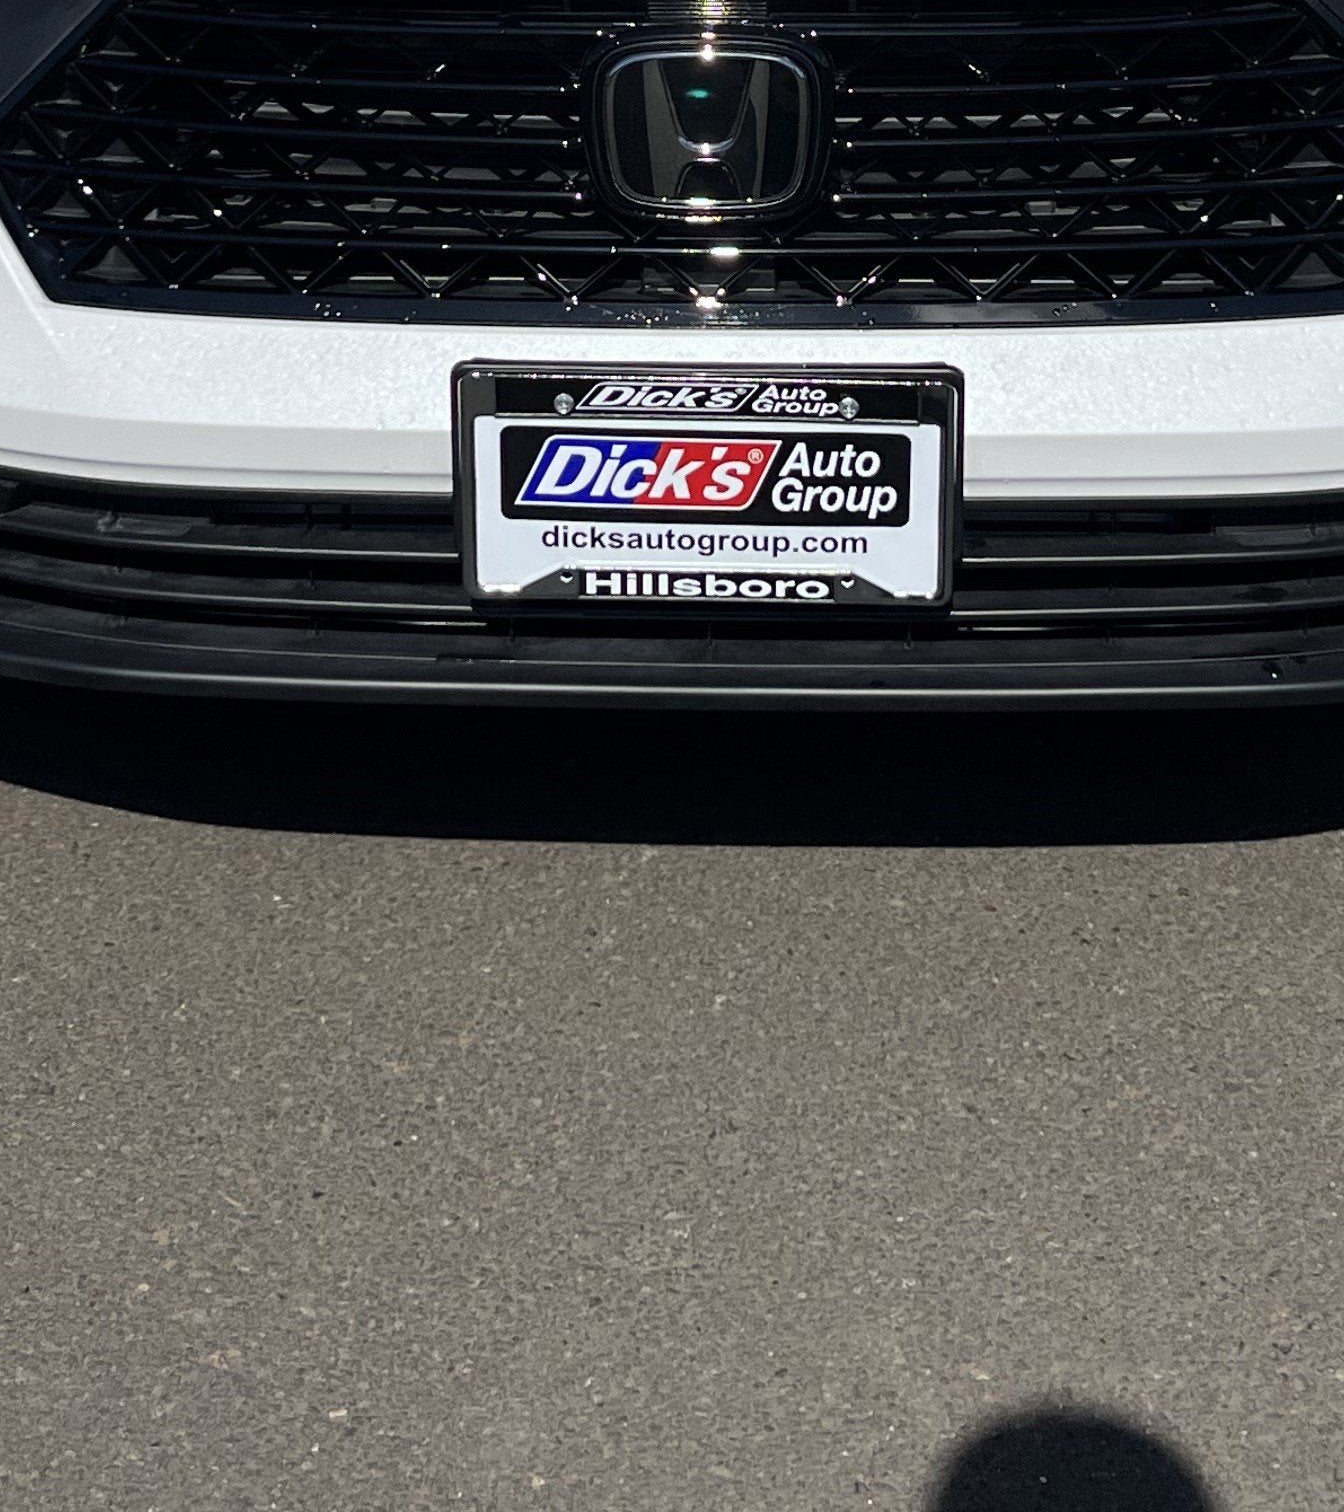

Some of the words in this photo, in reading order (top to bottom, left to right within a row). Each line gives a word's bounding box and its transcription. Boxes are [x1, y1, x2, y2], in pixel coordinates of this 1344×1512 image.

[589, 386, 738, 408] Dick's
[752, 398, 839, 417] Group
[759, 385, 827, 401] Auto
[535, 444, 752, 501] Dick's
[779, 442, 881, 478] Auto
[771, 477, 898, 519] Group
[542, 525, 868, 556] dicksautogroup.com
[585, 572, 830, 599] Hillsboro
